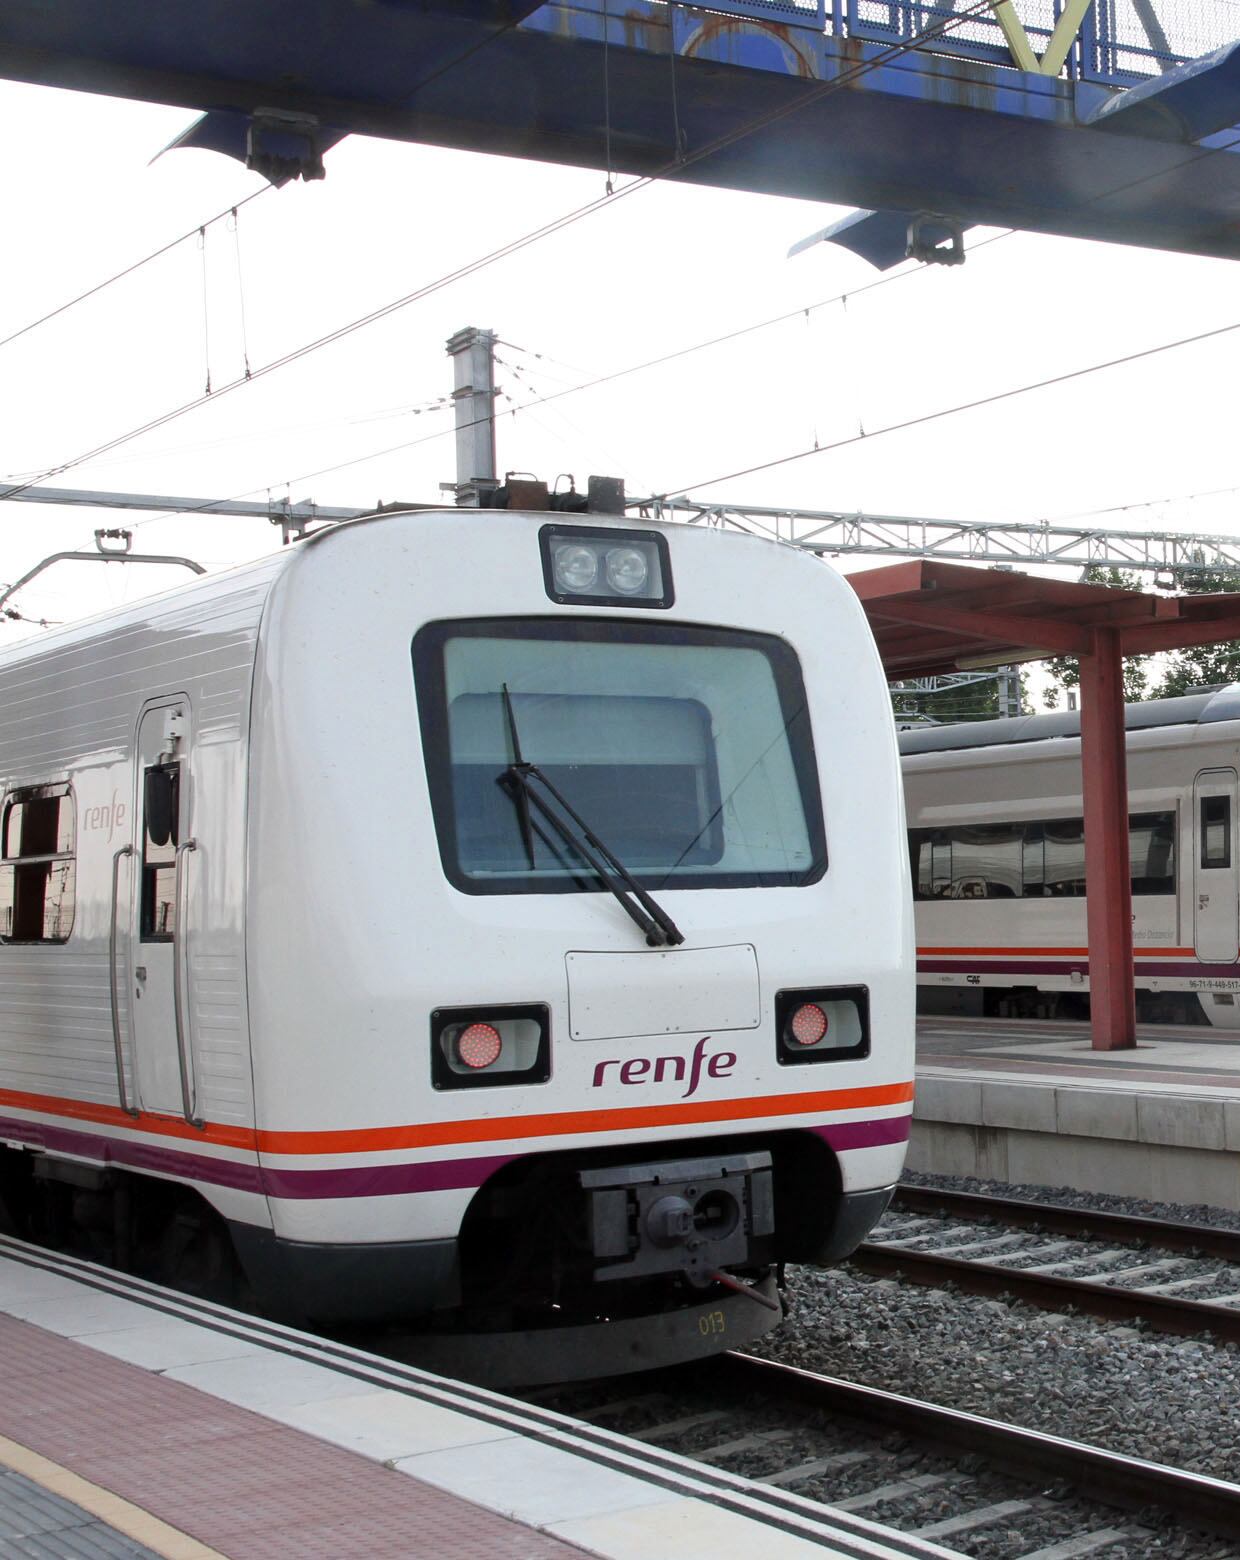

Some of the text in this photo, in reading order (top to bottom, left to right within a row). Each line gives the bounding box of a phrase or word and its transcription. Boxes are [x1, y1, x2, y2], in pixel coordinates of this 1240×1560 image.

[83, 787, 126, 844] renfe
[592, 1036, 737, 1098] renfe
[699, 1311, 725, 1336] 013
